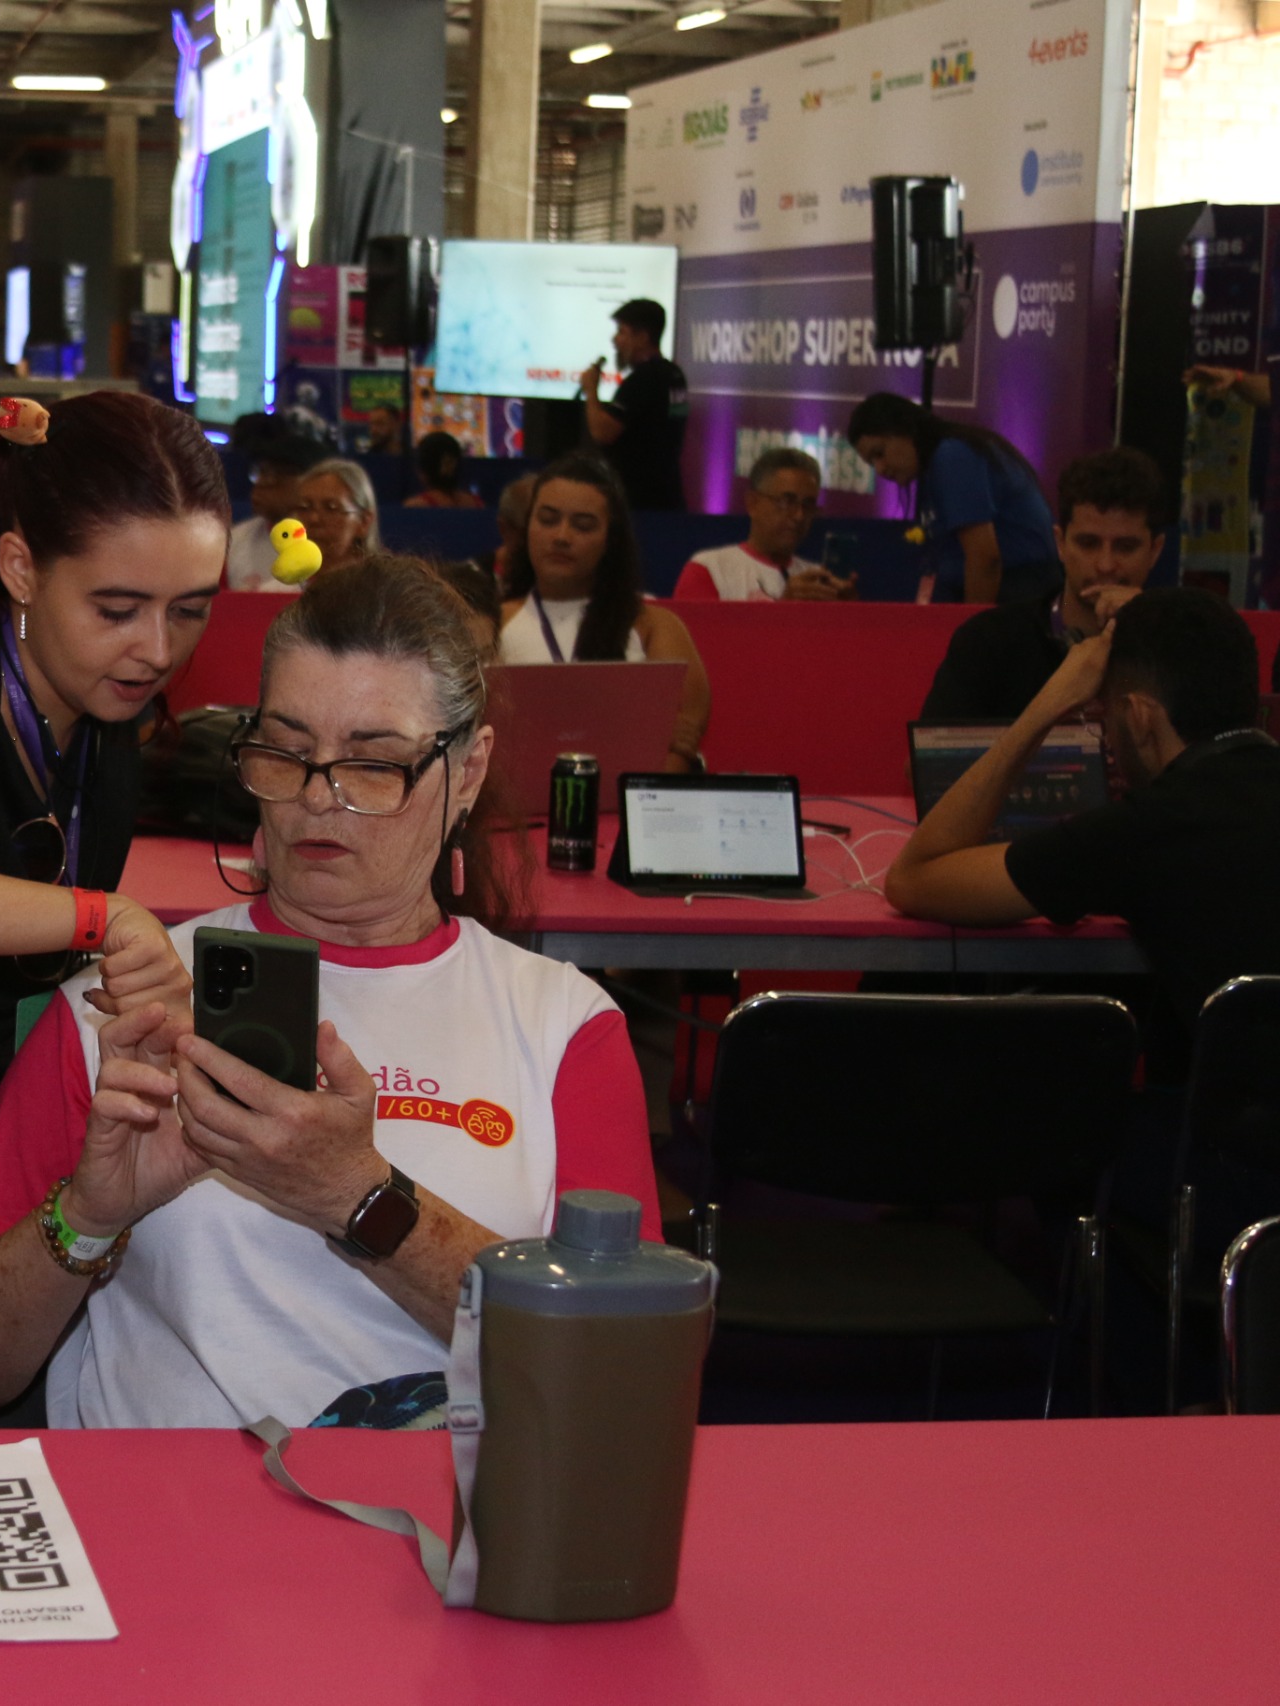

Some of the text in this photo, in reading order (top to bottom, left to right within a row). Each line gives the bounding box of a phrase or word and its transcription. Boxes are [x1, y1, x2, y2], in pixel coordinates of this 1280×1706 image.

[1028, 27, 1088, 65] 4events
[1020, 281, 1076, 306] campus
[1018, 305, 1056, 337] party
[691, 319, 801, 364] WORKSHOP
[1, 1604, 85, 1615] DESAFIO
